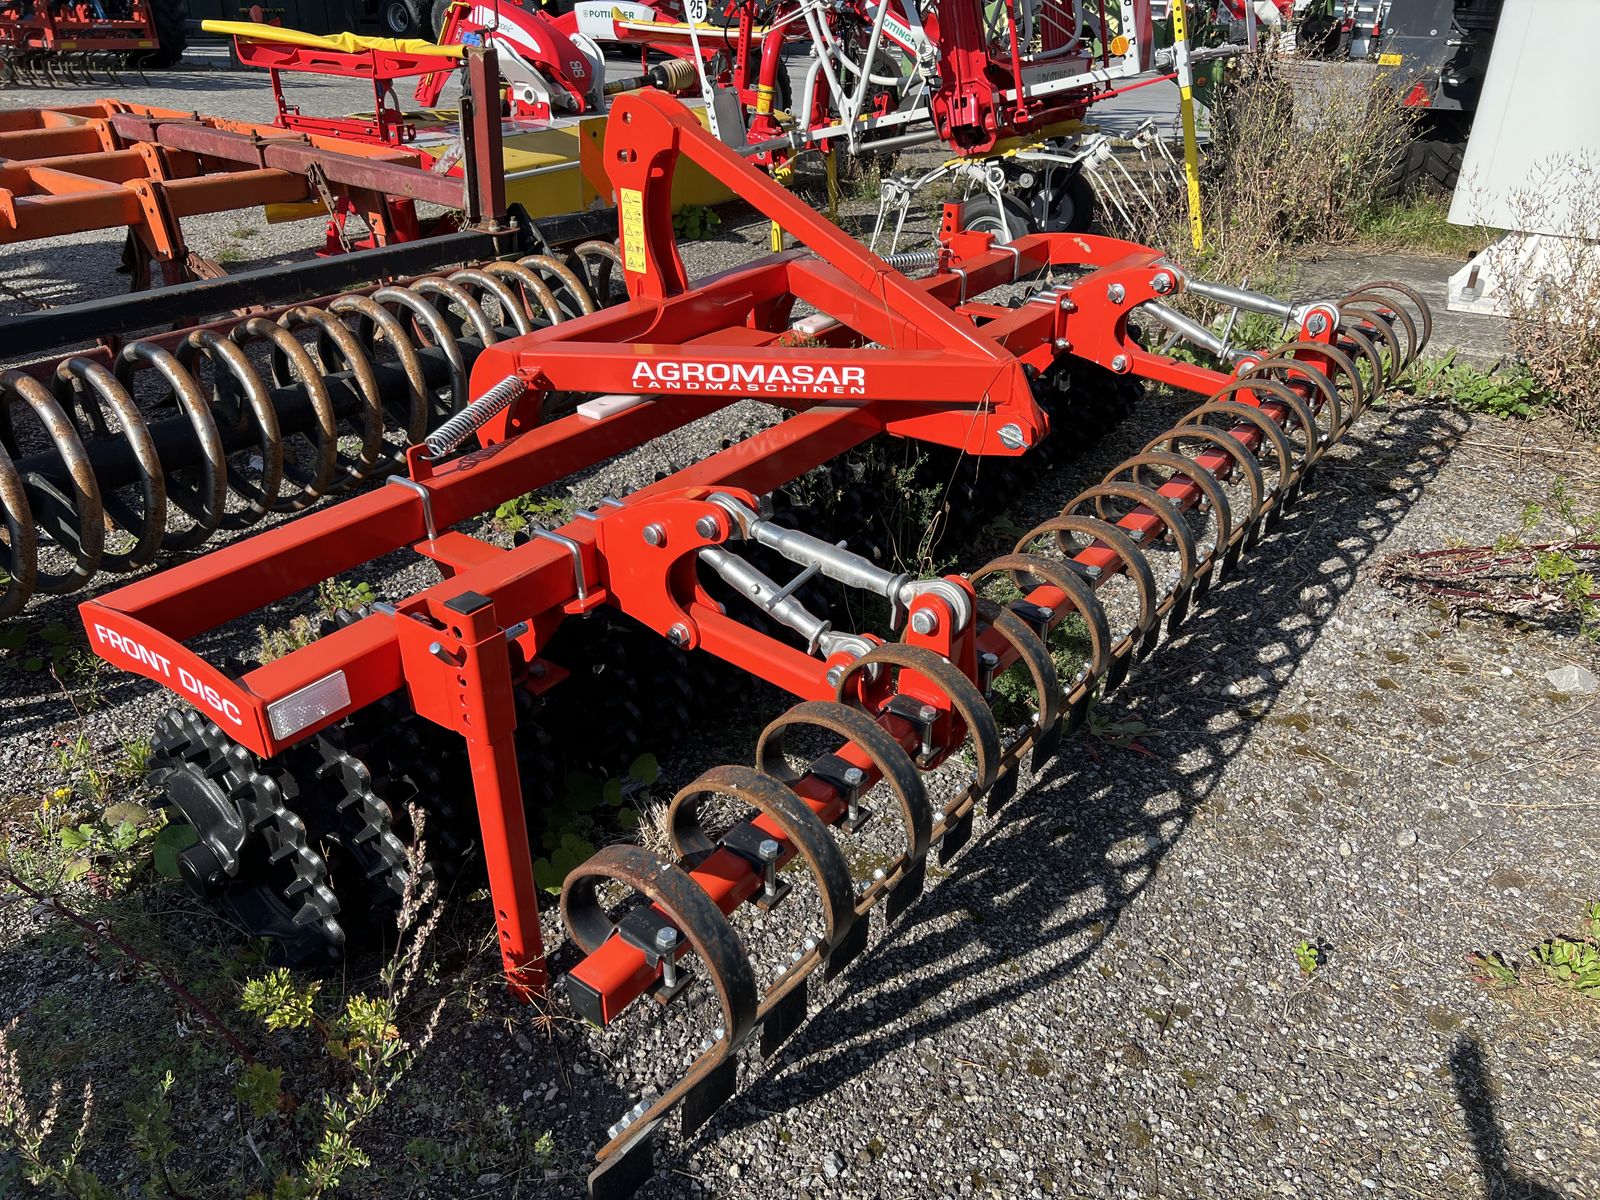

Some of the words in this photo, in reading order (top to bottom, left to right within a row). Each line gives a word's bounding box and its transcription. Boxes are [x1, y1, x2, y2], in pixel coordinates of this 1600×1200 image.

[690, 0, 703, 19] 25
[632, 361, 865, 386] AGROMASAR
[633, 380, 865, 394] LANDMASCHINEN
[94, 623, 170, 677] FRONT
[178, 667, 242, 725] DISC
